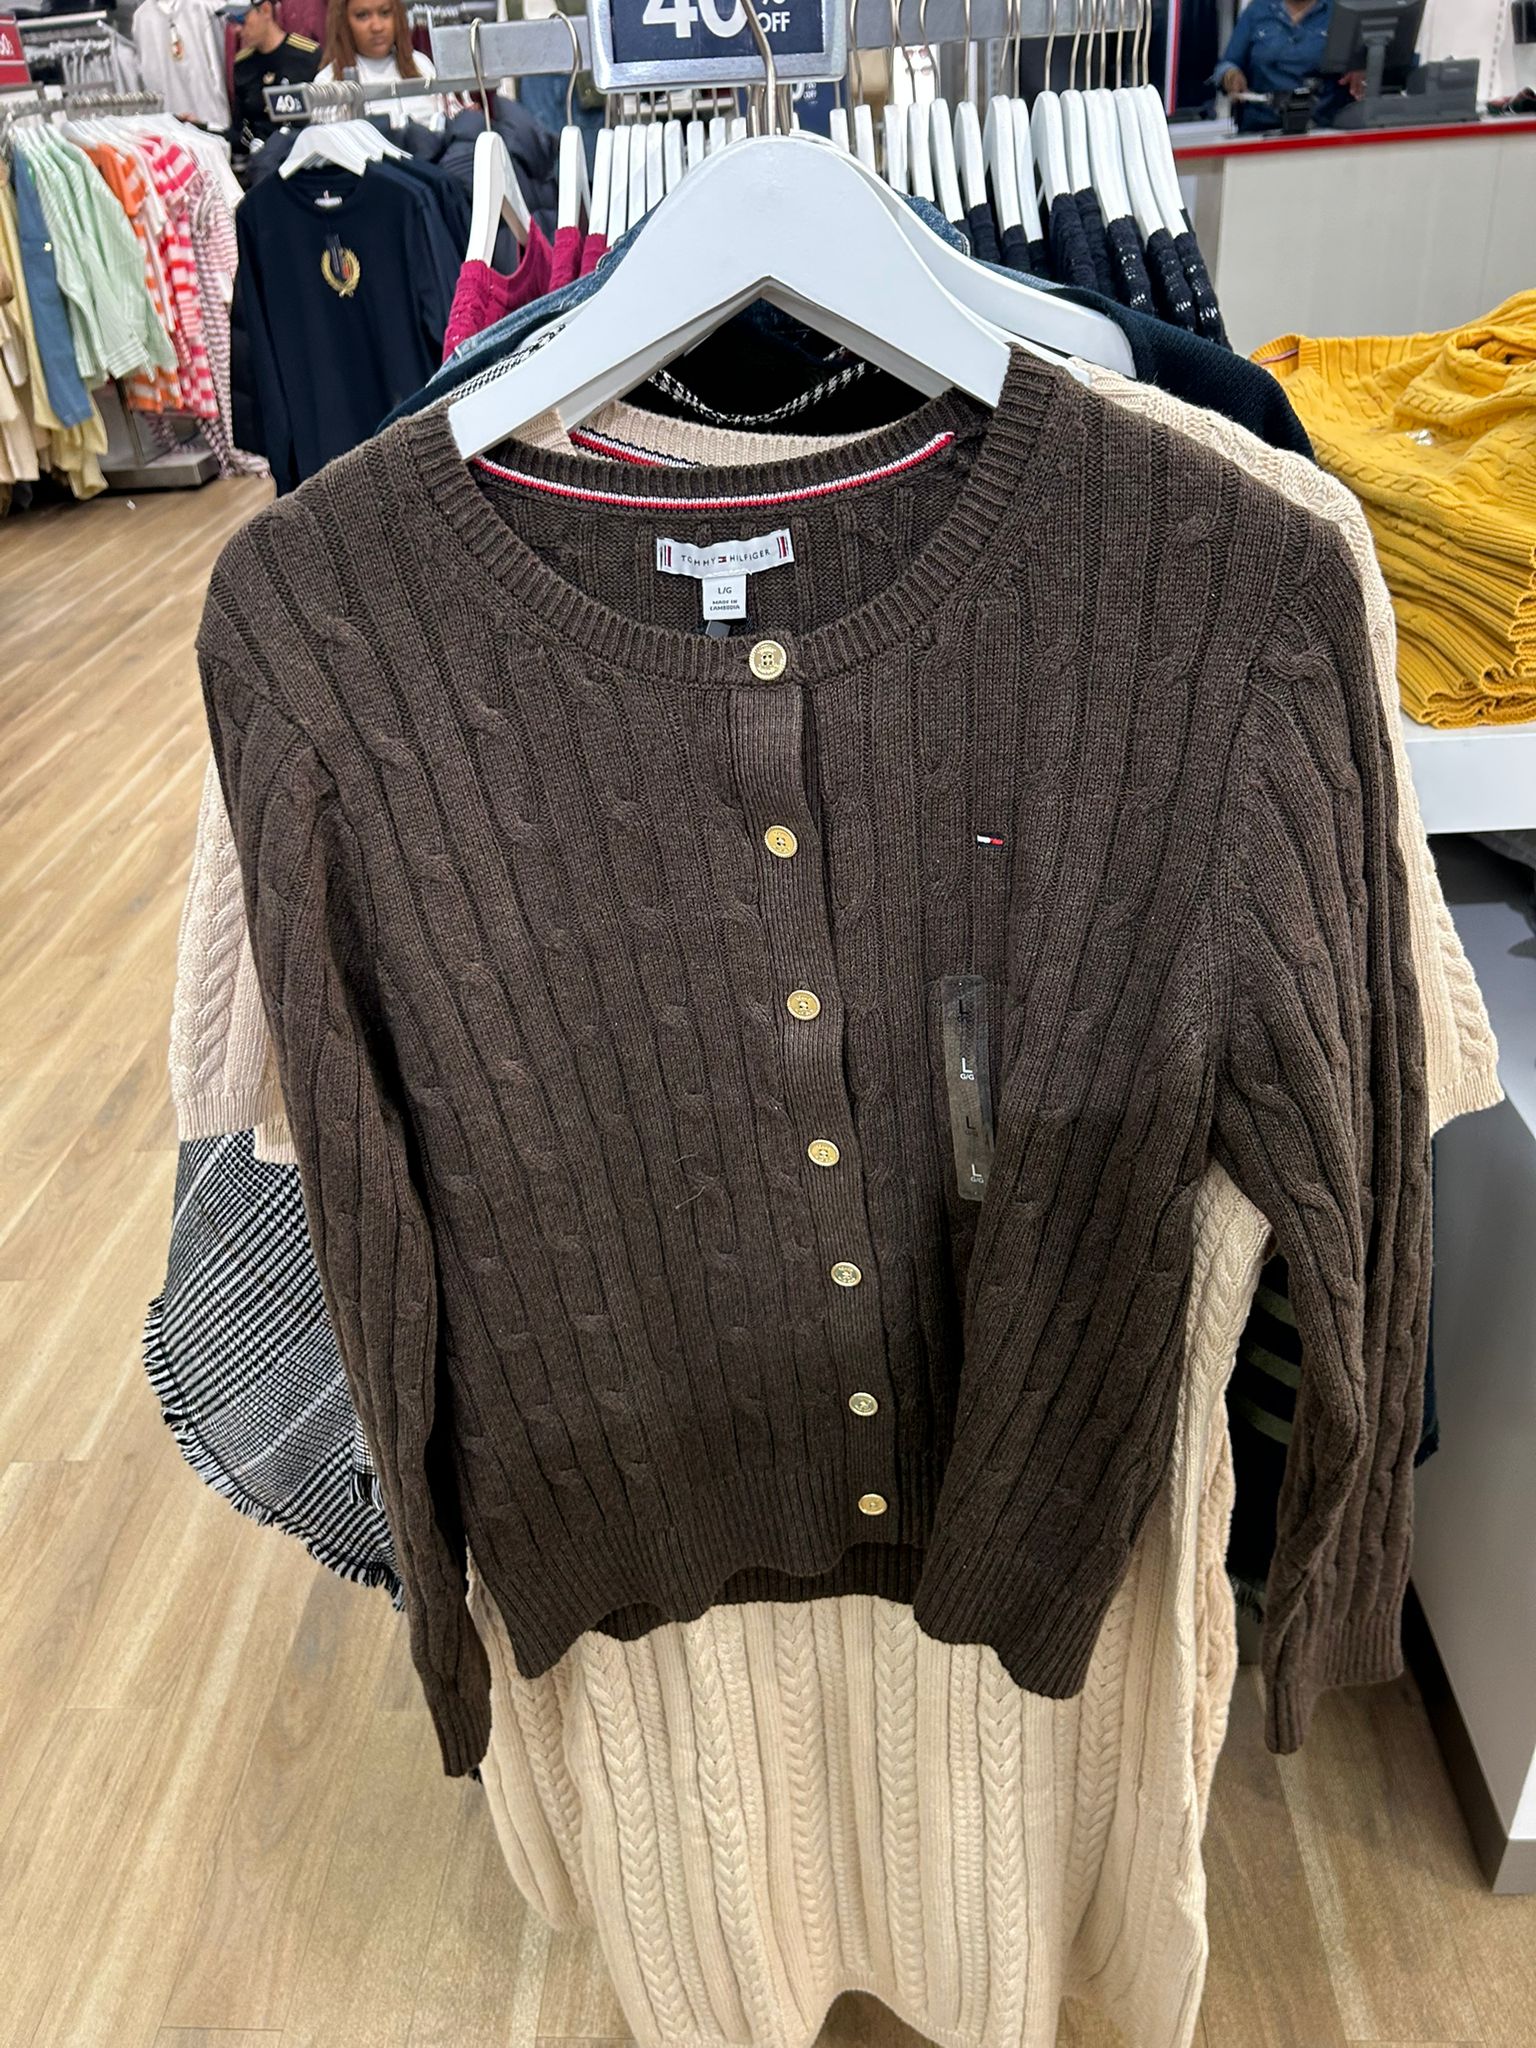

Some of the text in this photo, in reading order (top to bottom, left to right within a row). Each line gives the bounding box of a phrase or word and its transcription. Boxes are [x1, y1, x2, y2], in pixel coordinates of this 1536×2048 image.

[757, 11, 790, 33] OFF
[681, 549, 770, 566] TOMMY HILFIGER
[717, 586, 732, 595] L/G
[961, 1057, 973, 1073] L
[960, 1073, 975, 1081] G/G
[971, 1163, 982, 1178] L
